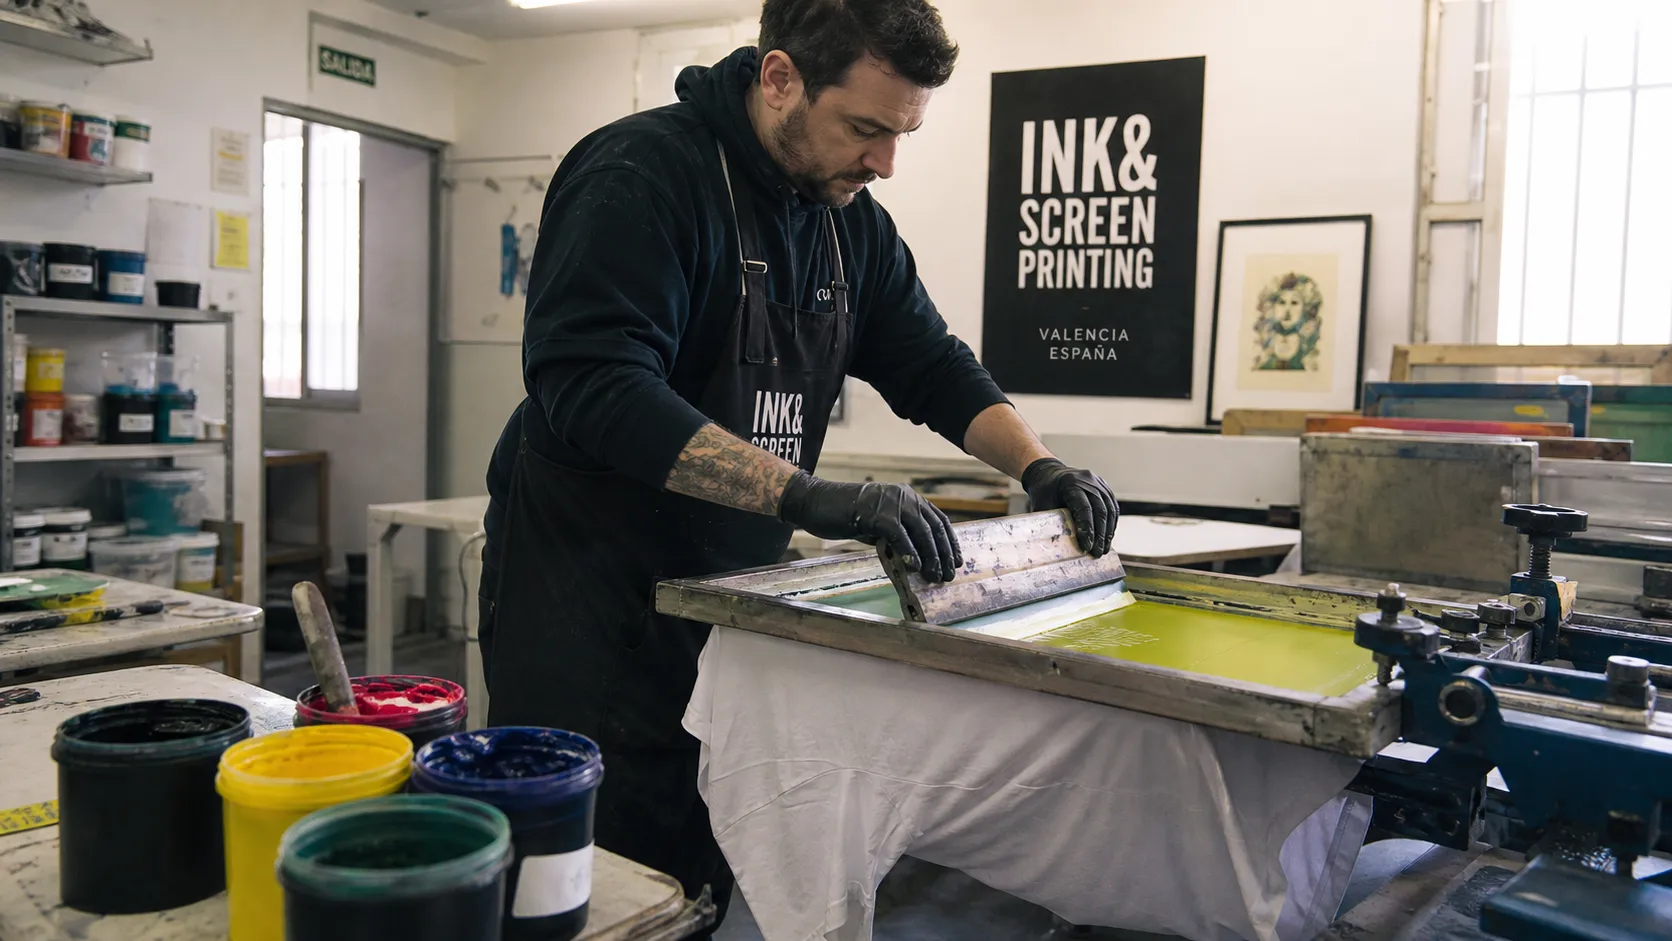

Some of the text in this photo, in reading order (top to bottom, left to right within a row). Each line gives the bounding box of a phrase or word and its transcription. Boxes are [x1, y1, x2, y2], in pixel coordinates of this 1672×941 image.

[321, 50, 374, 82] SALIDA
[1021, 113, 1157, 194] INK&
[1018, 196, 1156, 246] SCREEN
[1017, 247, 1154, 289] PRINTING
[1039, 328, 1129, 341] VALENCIA
[1049, 344, 1117, 360] ESPAÑA
[752, 390, 803, 434] INK&
[751, 436, 802, 464] REEN
